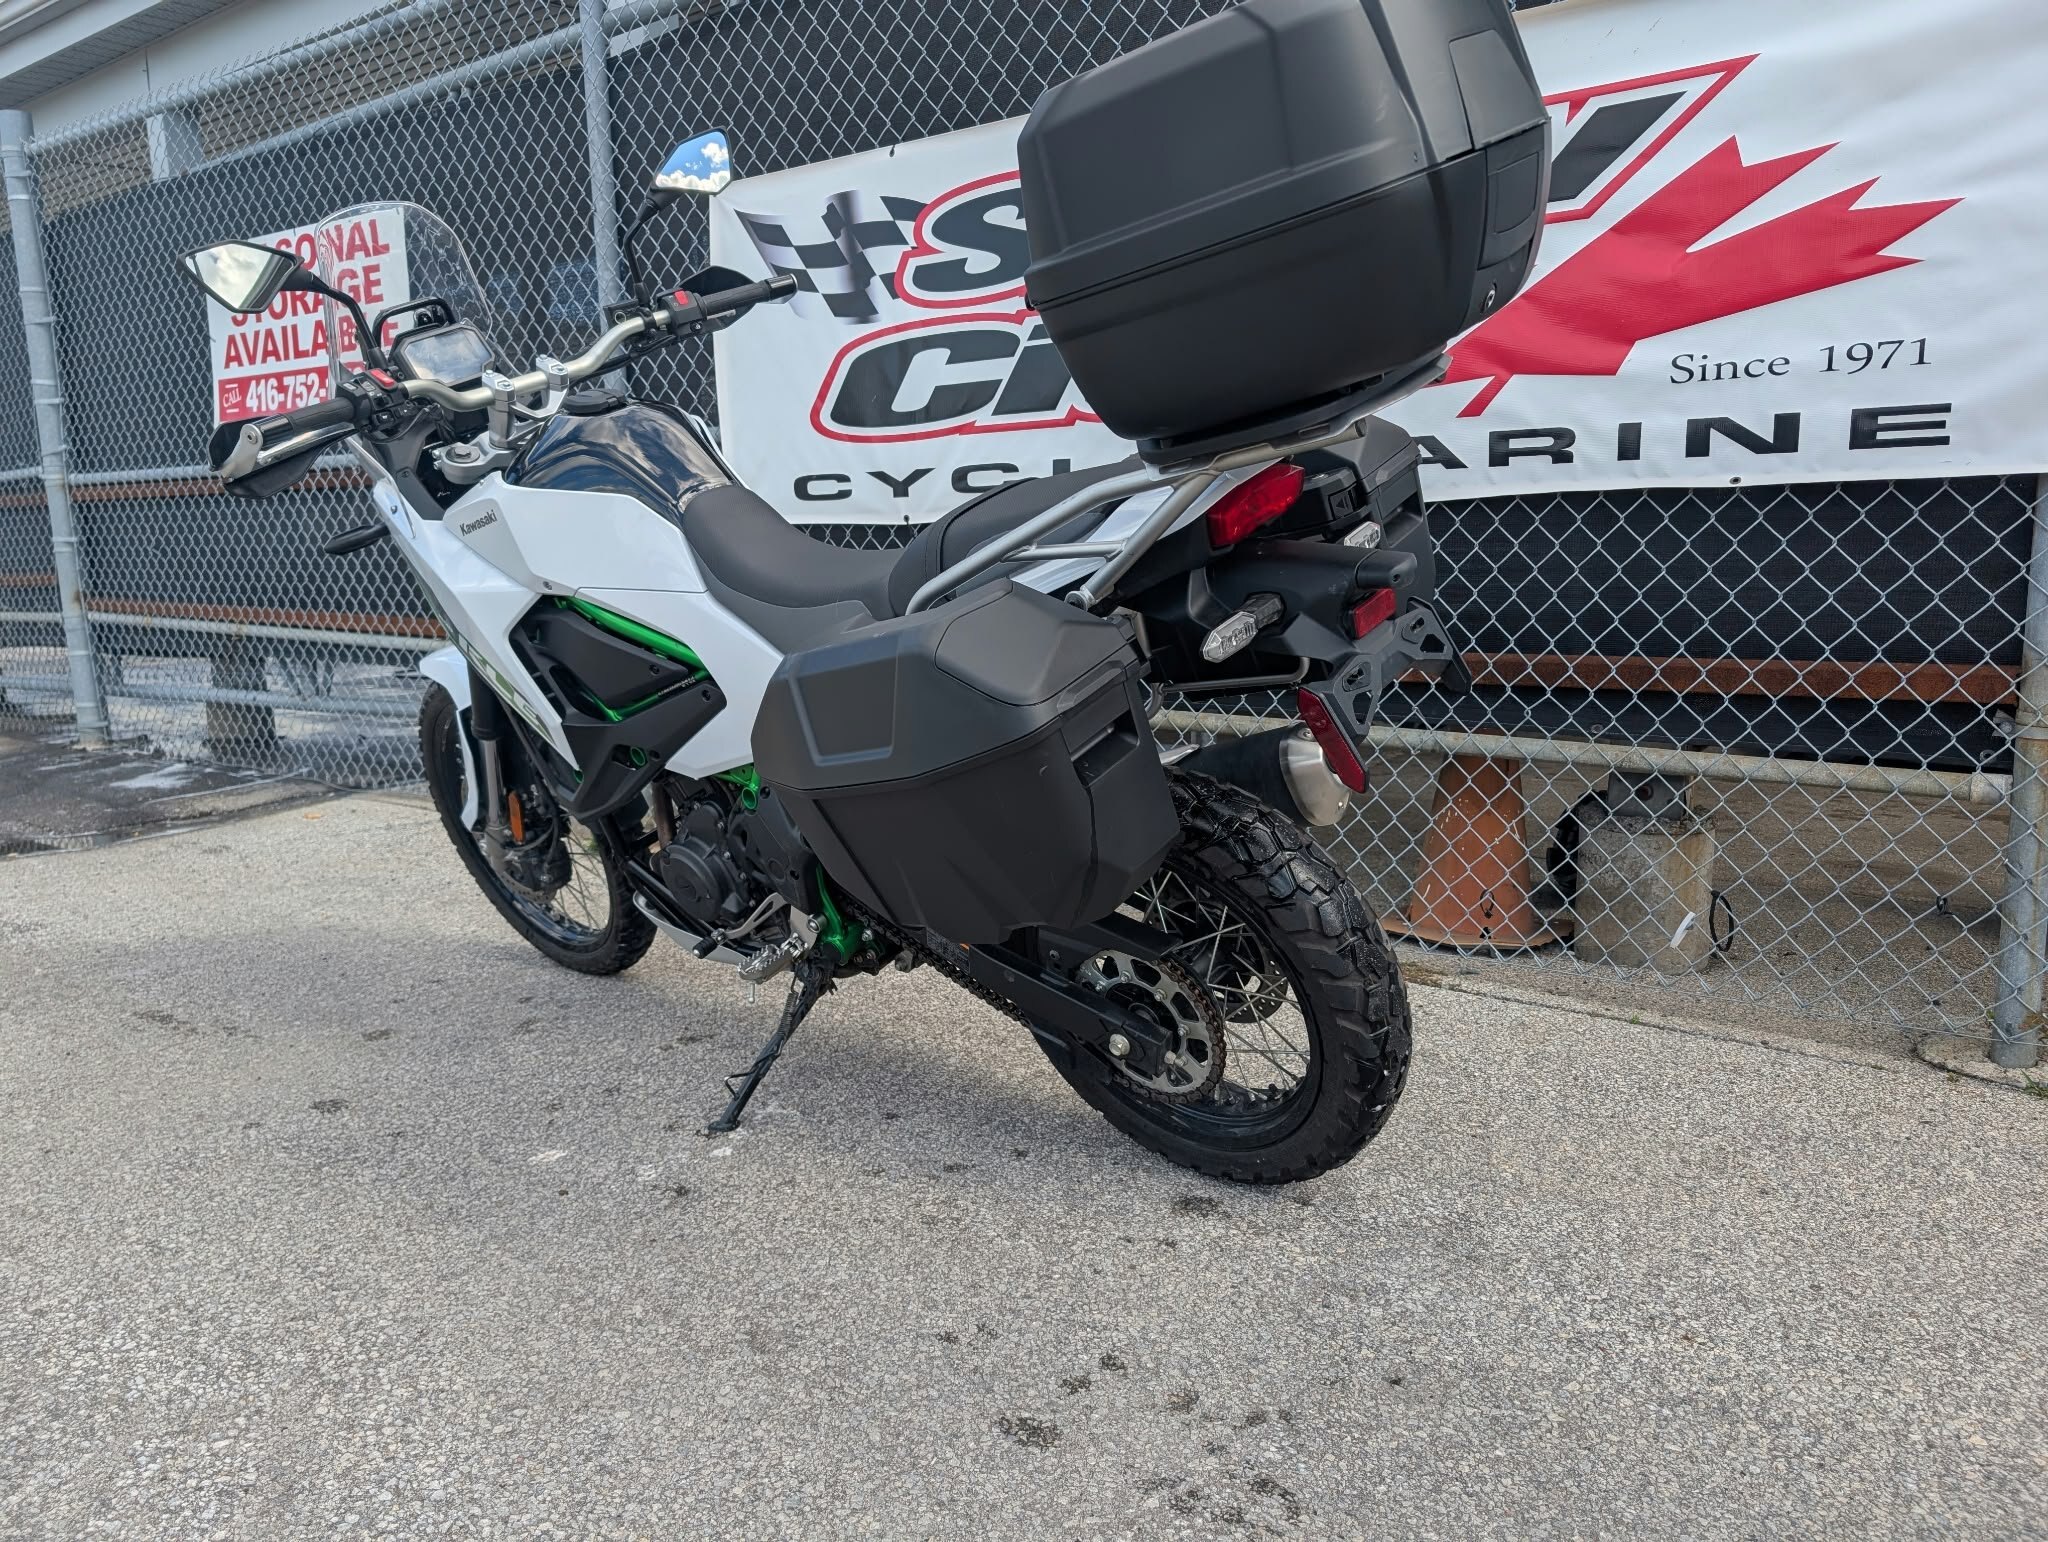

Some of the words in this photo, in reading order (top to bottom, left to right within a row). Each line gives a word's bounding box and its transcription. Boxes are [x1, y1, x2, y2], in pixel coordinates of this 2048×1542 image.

[224, 312, 399, 369] AVAILABE
[1670, 353, 1790, 384] Since
[1819, 337, 1932, 375] 1971
[223, 387, 242, 408] CALL
[1411, 402, 1952, 470] ARINE
[460, 509, 498, 537] Kawasaki
